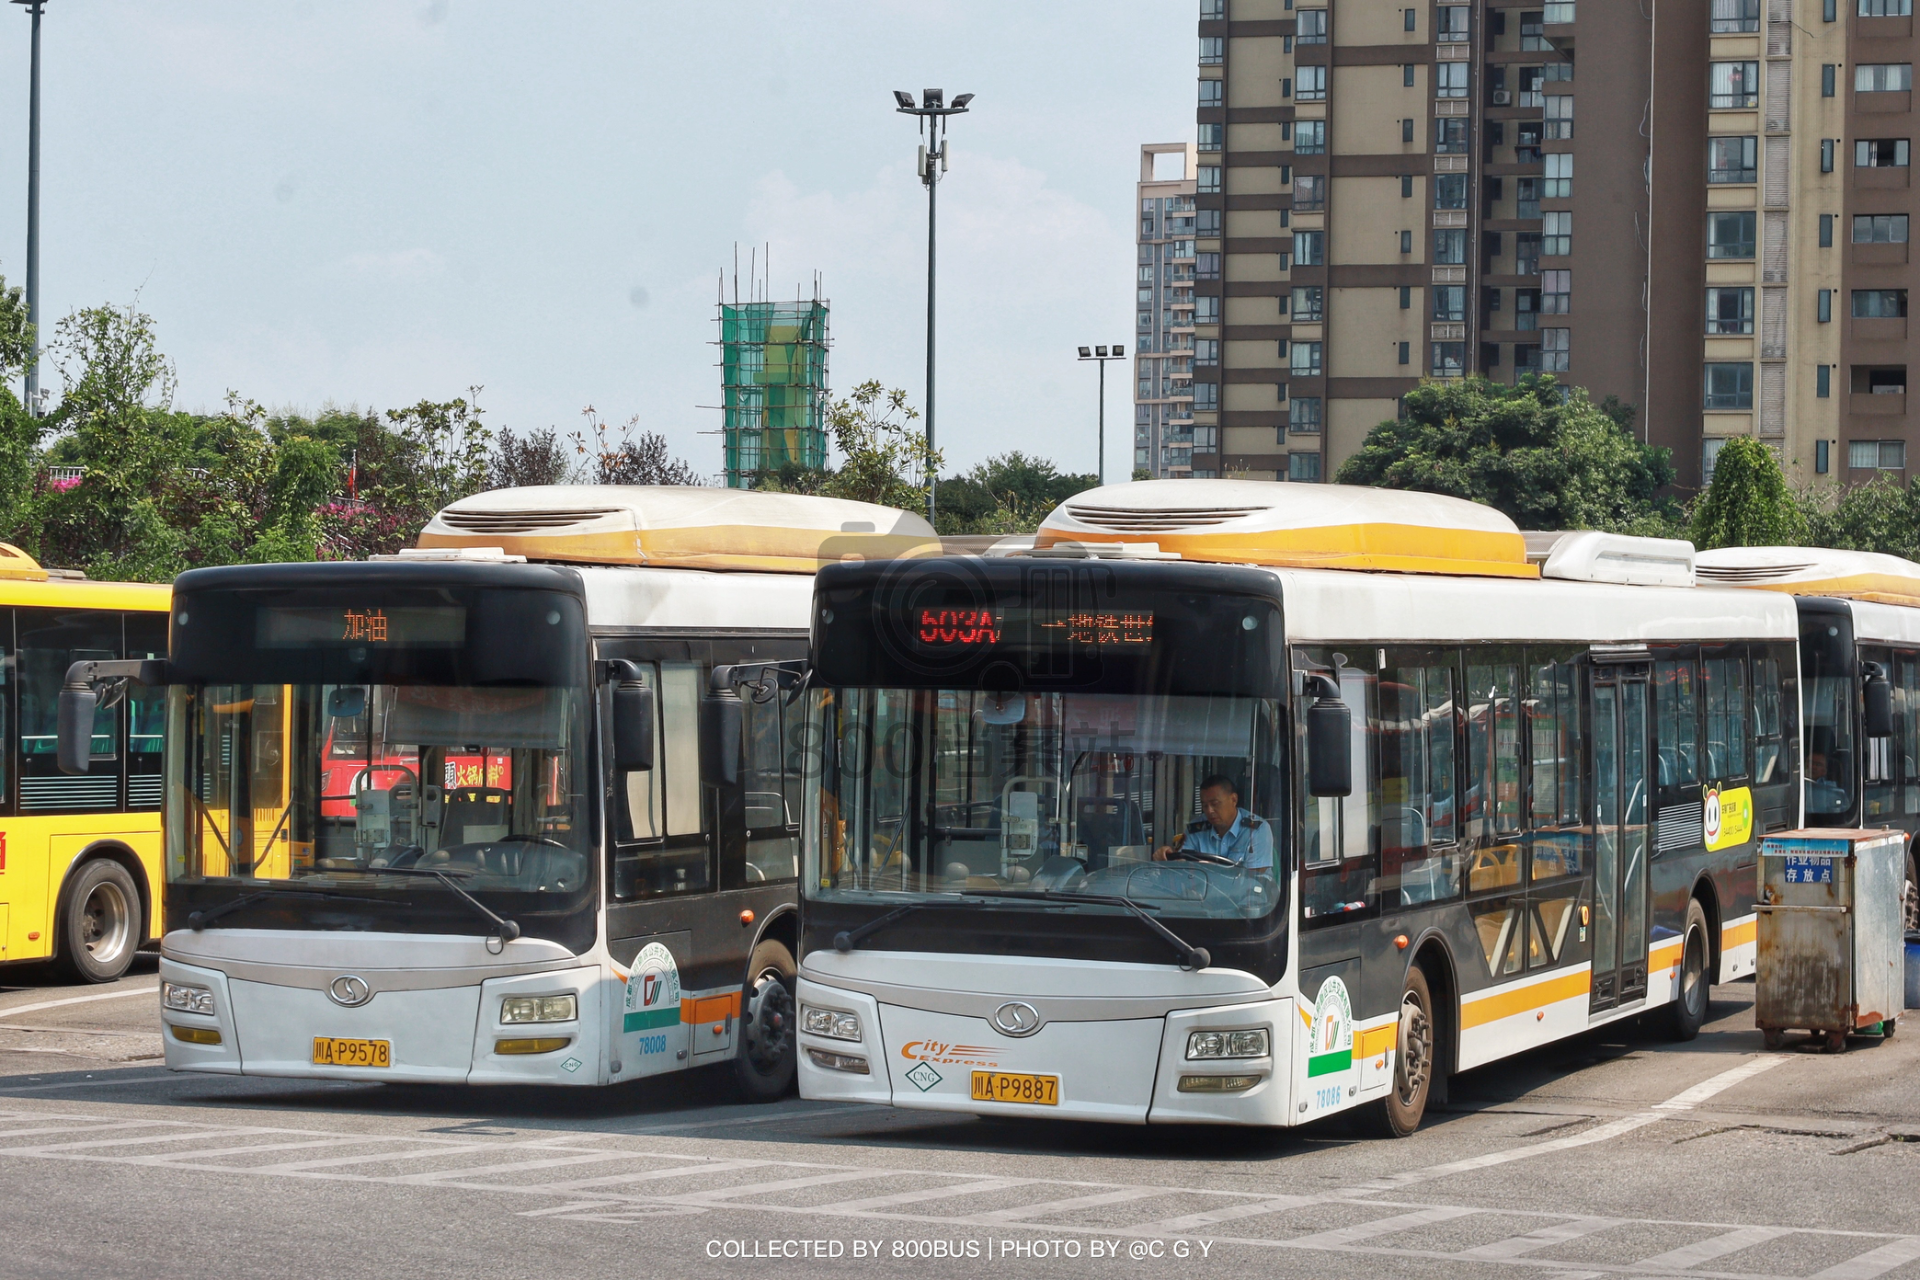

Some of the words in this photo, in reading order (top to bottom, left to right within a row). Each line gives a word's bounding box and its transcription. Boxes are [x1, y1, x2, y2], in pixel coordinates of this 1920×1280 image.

[343, 608, 387, 642] 加油
[1786, 868, 1831, 883] 存放点
[639, 1035, 666, 1055] 78008
[901, 1039, 950, 1060] City
[918, 1055, 998, 1068] Express
[913, 1071, 935, 1083] CNG
[1316, 1085, 1341, 1110] 78086
